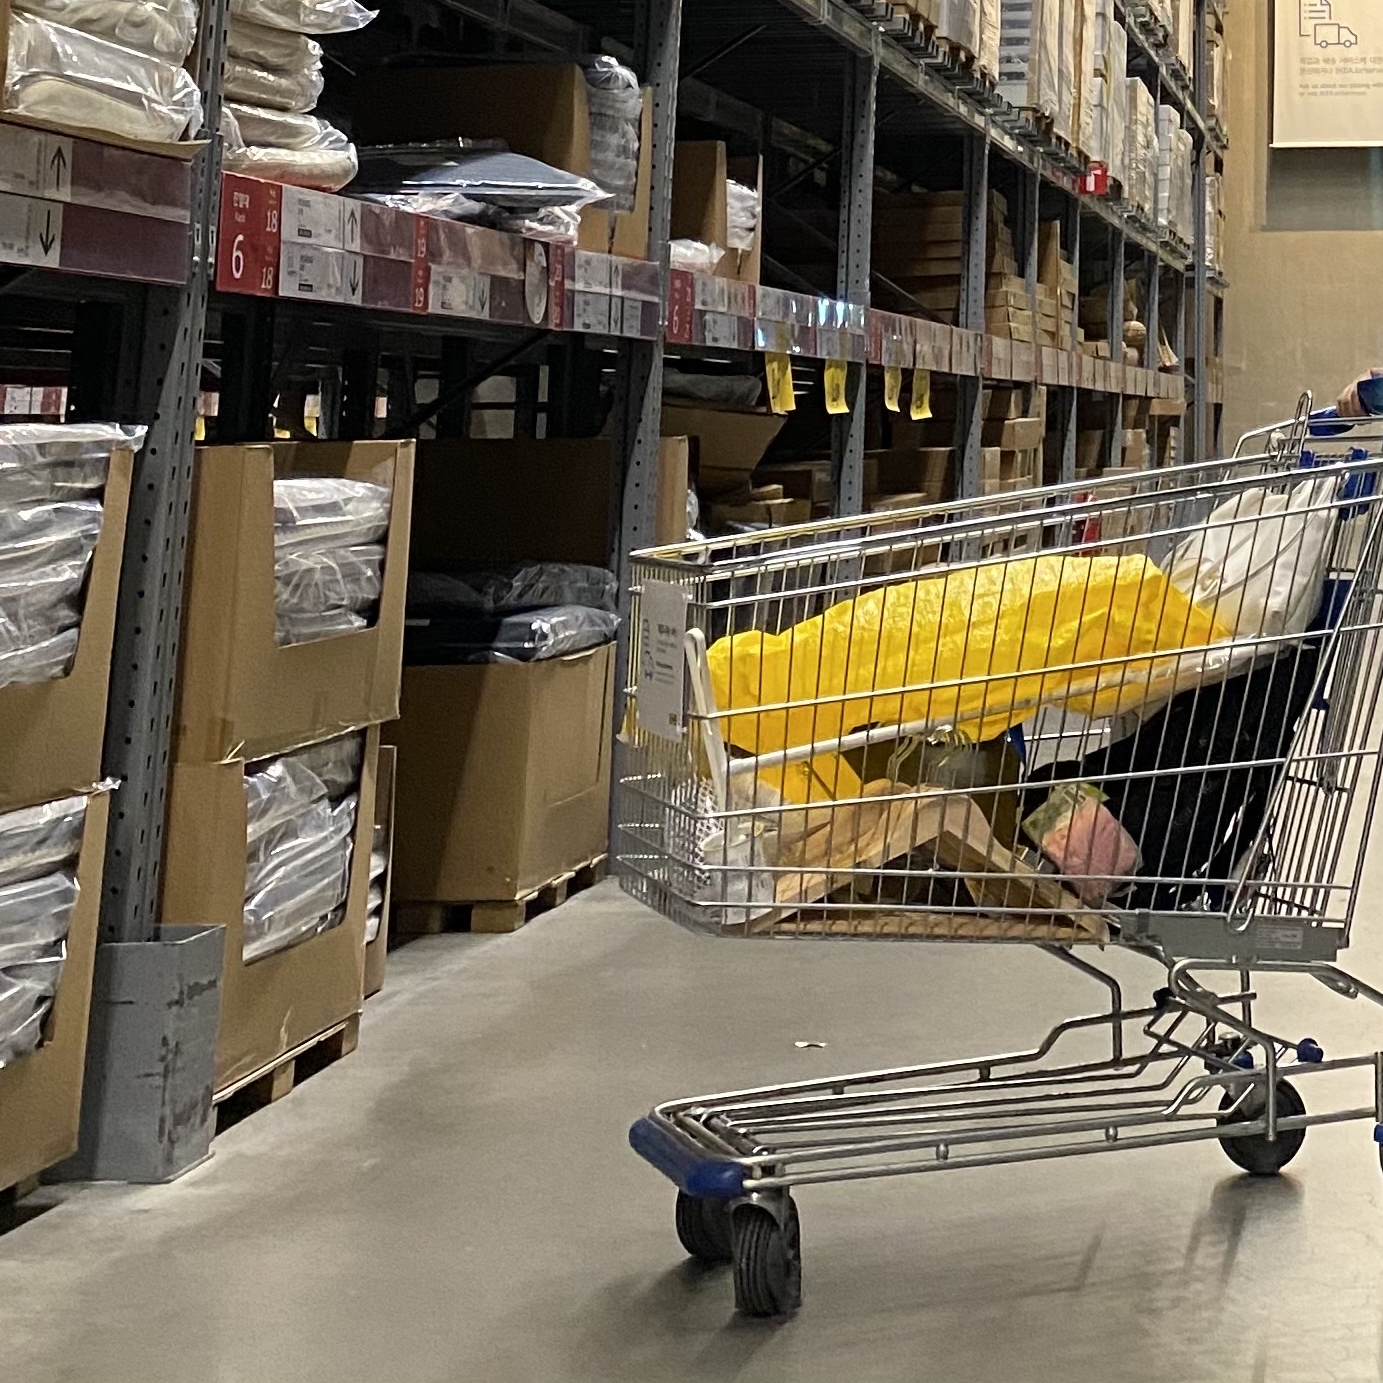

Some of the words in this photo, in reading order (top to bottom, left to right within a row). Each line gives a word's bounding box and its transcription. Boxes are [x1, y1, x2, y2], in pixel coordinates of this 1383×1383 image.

[265, 209, 278, 233] 18
[231, 233, 245, 280] 6
[260, 266, 274, 290] 18
[414, 287, 425, 308] 19
